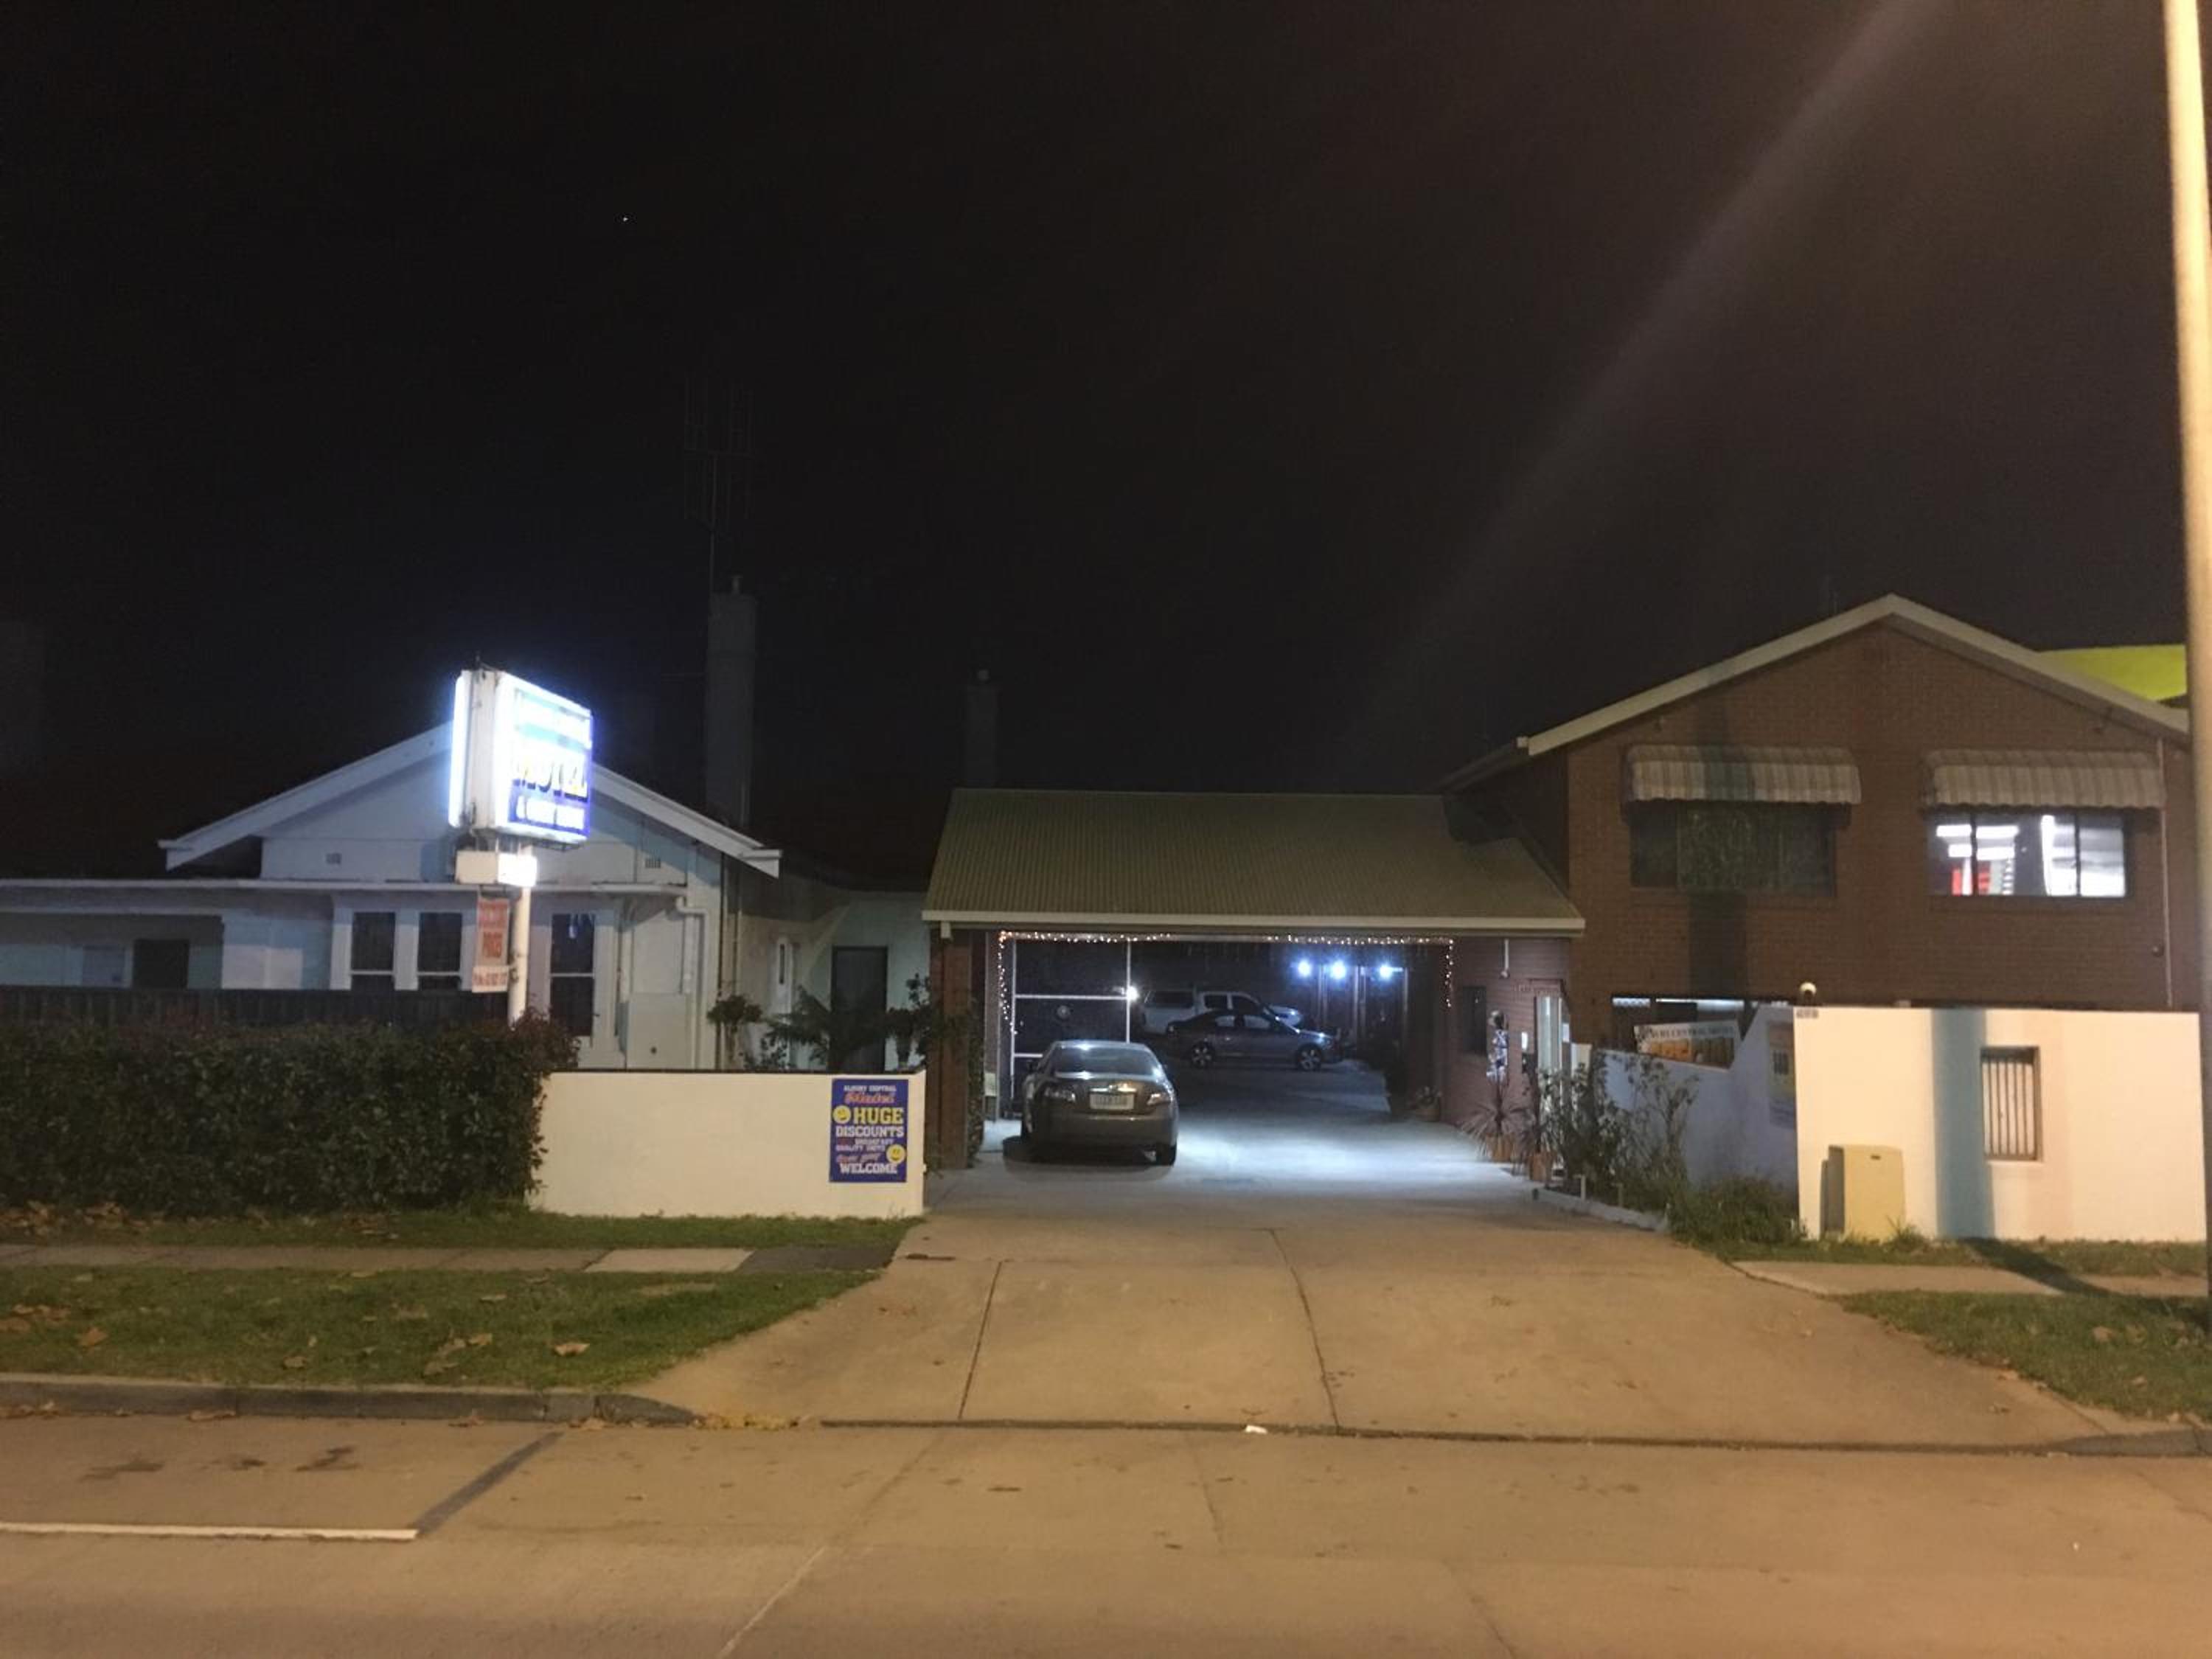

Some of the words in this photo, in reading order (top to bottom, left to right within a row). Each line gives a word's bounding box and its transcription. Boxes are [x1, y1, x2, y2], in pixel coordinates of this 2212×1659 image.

[853, 1107, 904, 1124] HUGE
[835, 1125, 904, 1138] DISCOUNTS
[840, 1163, 898, 1174] WELCOME
